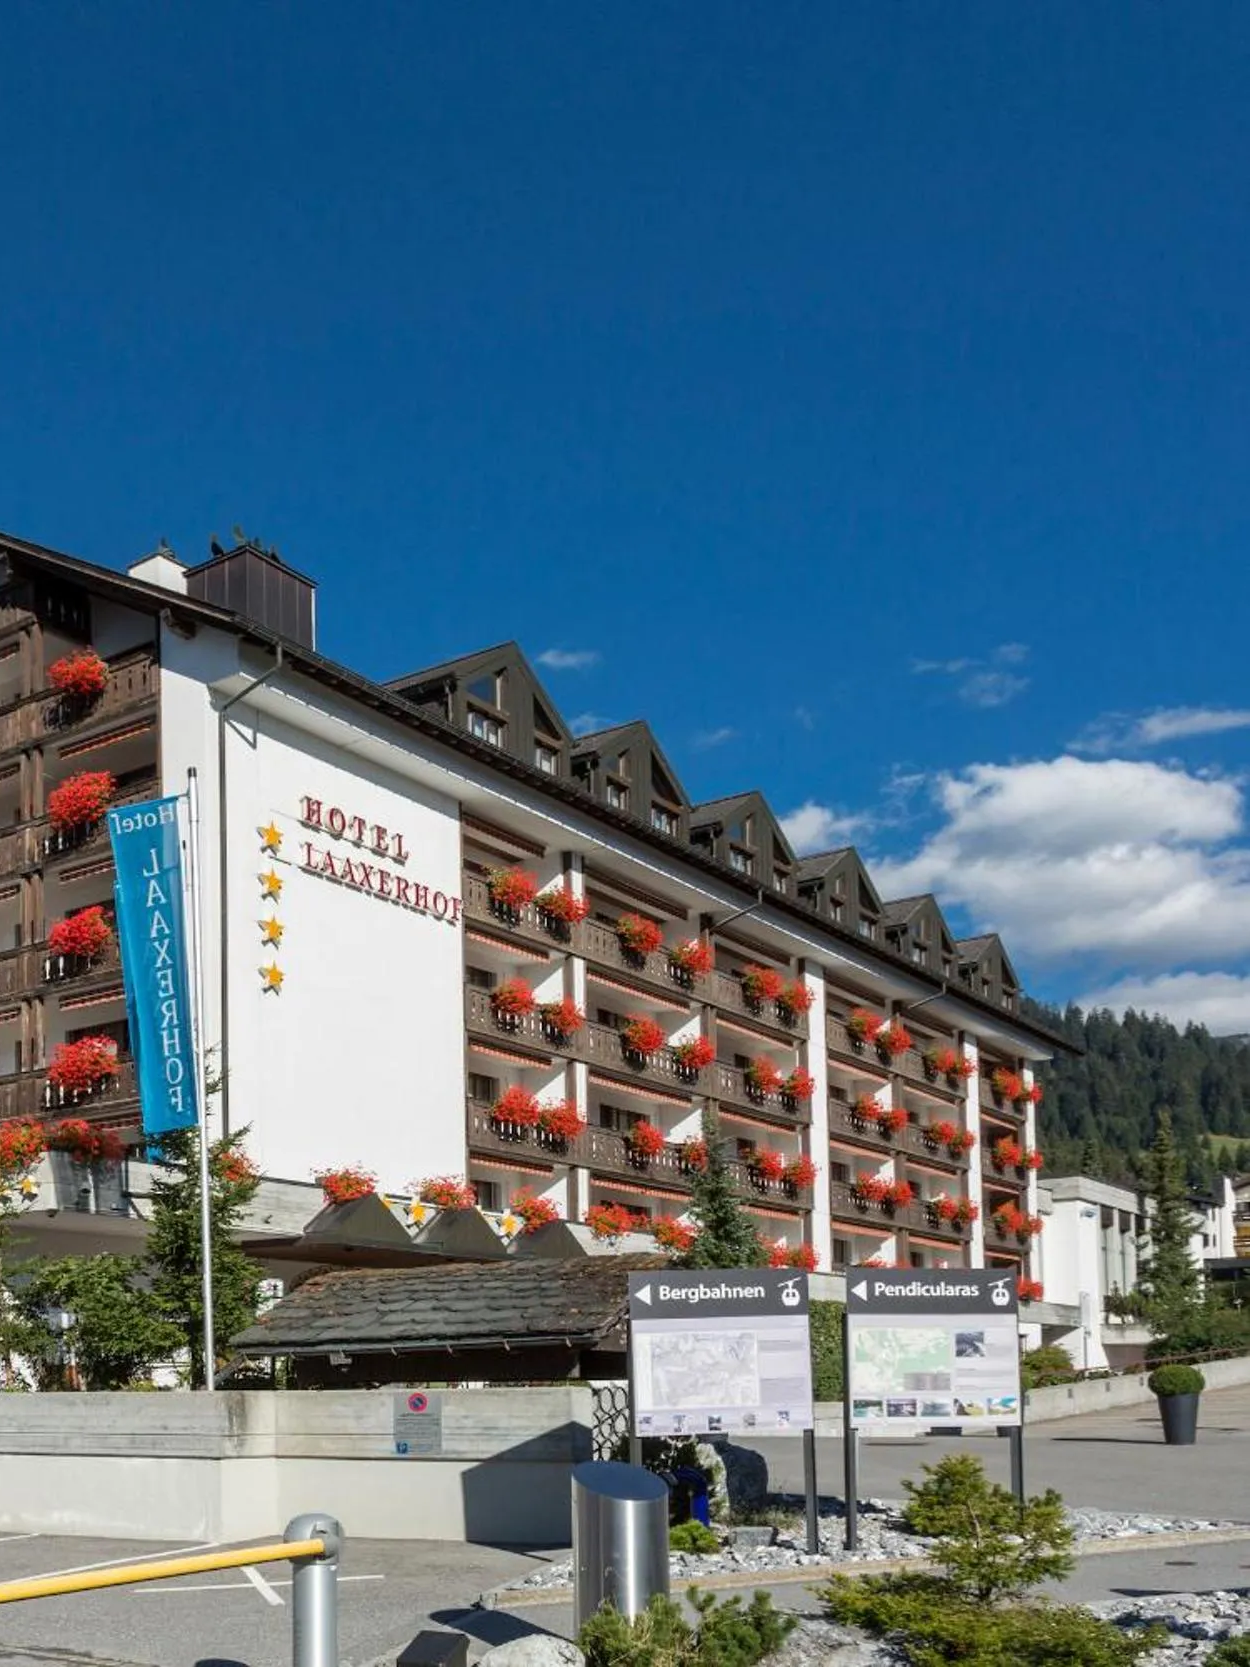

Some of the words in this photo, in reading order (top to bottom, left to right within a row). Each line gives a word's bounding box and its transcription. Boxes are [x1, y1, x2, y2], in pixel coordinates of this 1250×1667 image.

[303, 796, 410, 862] HOTEL
[303, 841, 463, 921] LAAXERHOF
[659, 1282, 766, 1304] Bergbahnen
[873, 1280, 980, 1297] Pendicularas
